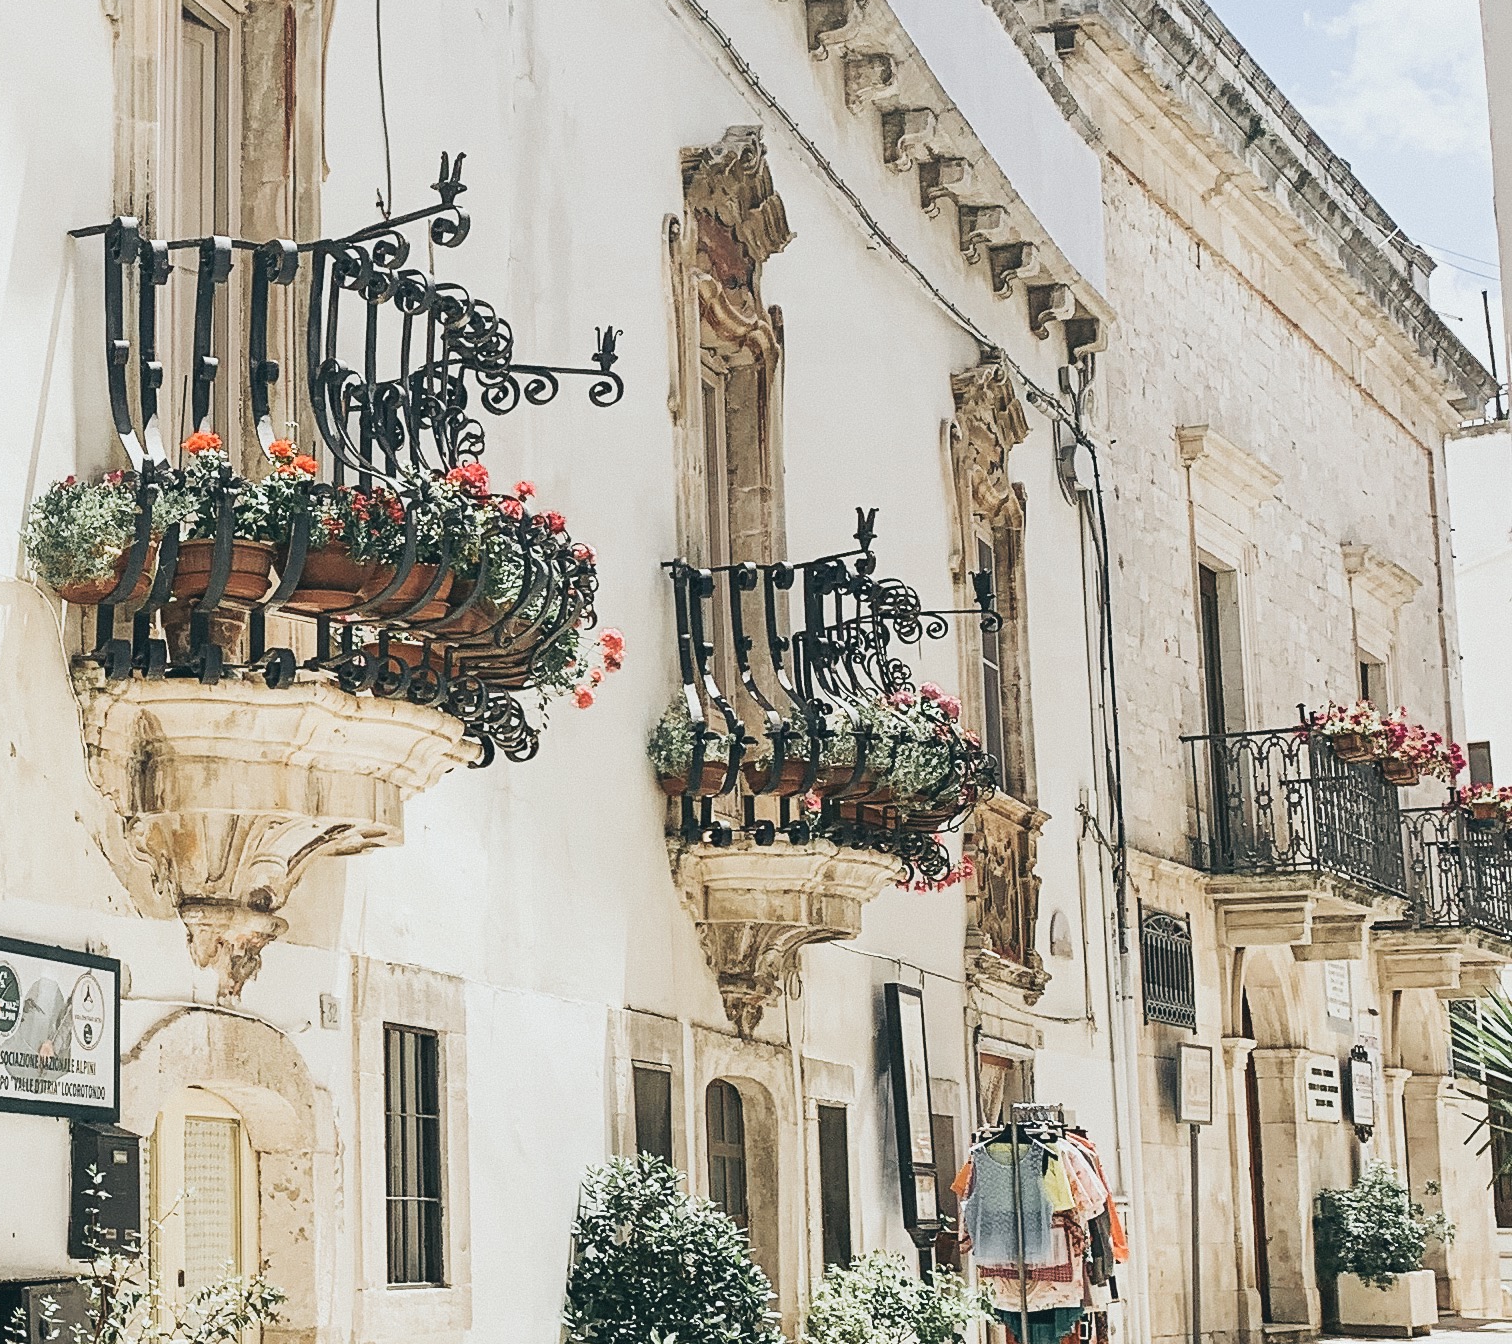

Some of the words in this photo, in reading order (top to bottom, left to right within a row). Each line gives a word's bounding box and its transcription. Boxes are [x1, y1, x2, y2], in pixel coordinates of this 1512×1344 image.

[39, 1055, 74, 1074] NAZIONALE
[75, 1059, 96, 1075] ALPINI
[61, 1081, 106, 1100] LOCOROTONDO
